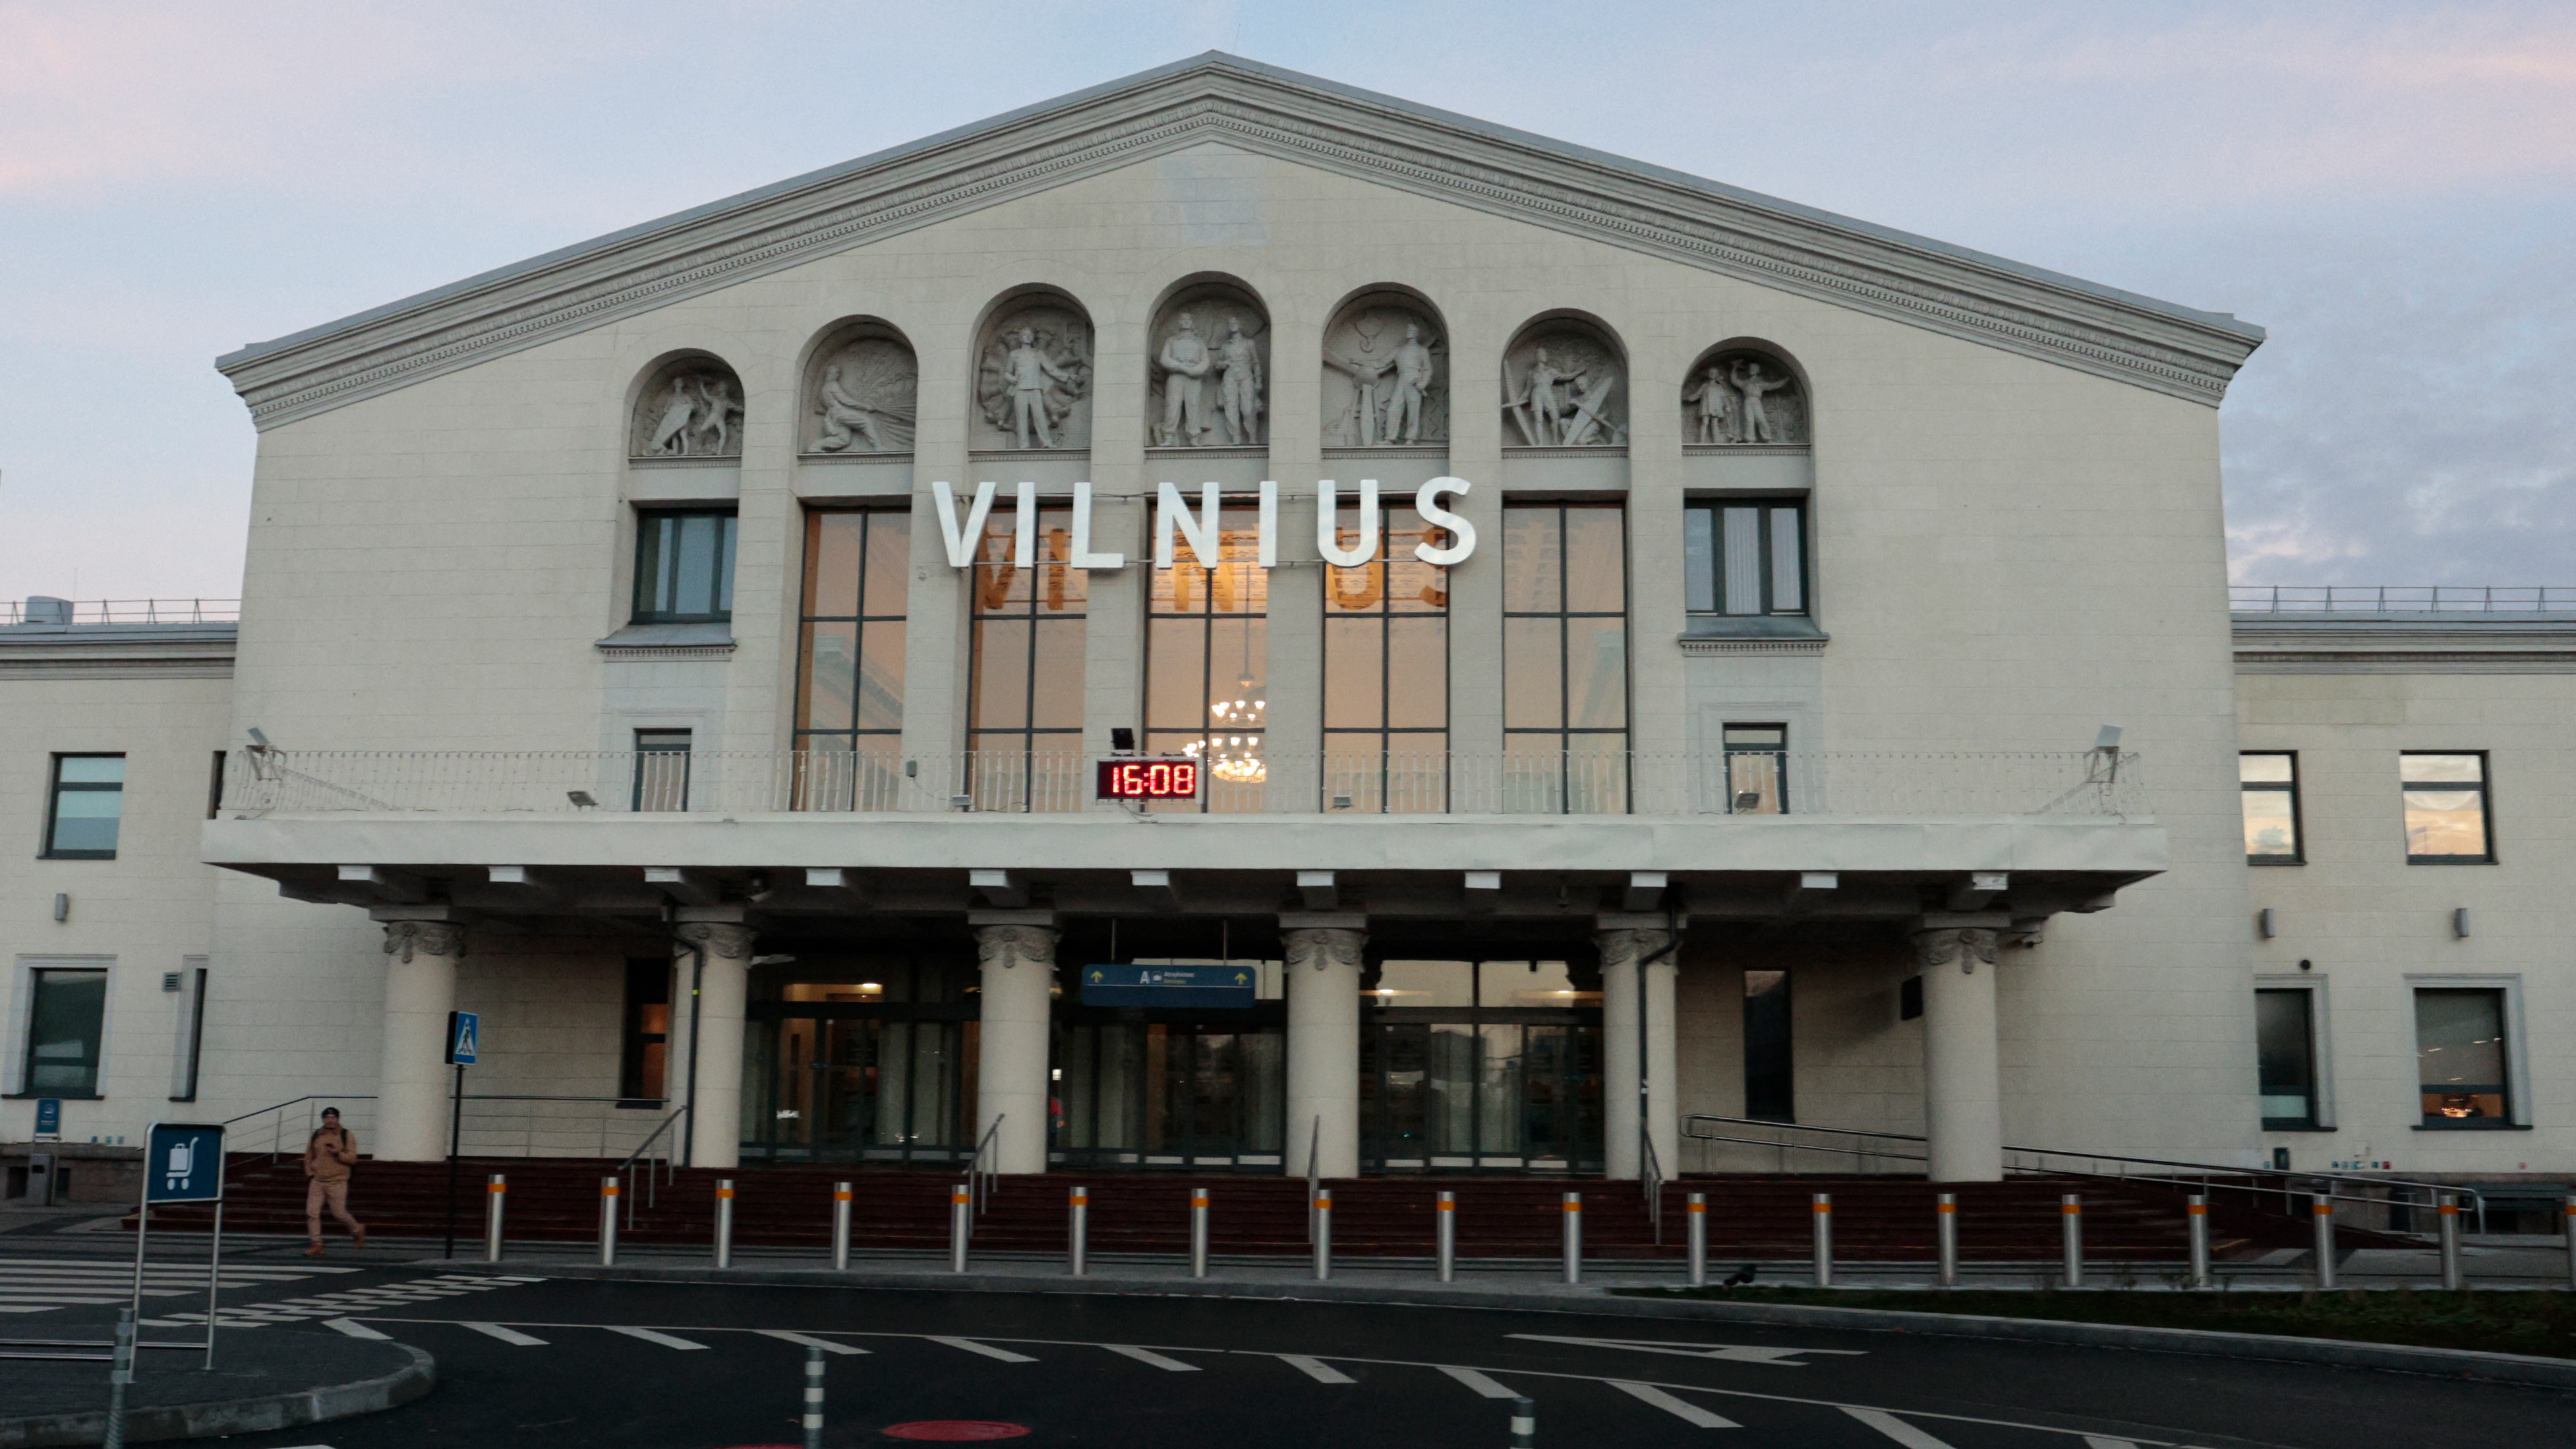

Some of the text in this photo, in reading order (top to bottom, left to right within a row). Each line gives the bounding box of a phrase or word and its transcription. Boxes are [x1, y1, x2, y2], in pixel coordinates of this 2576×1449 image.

[931, 476, 1477, 569] VILNIUS
[1112, 765, 1194, 794] 16:08
[1139, 970, 1150, 984] A
